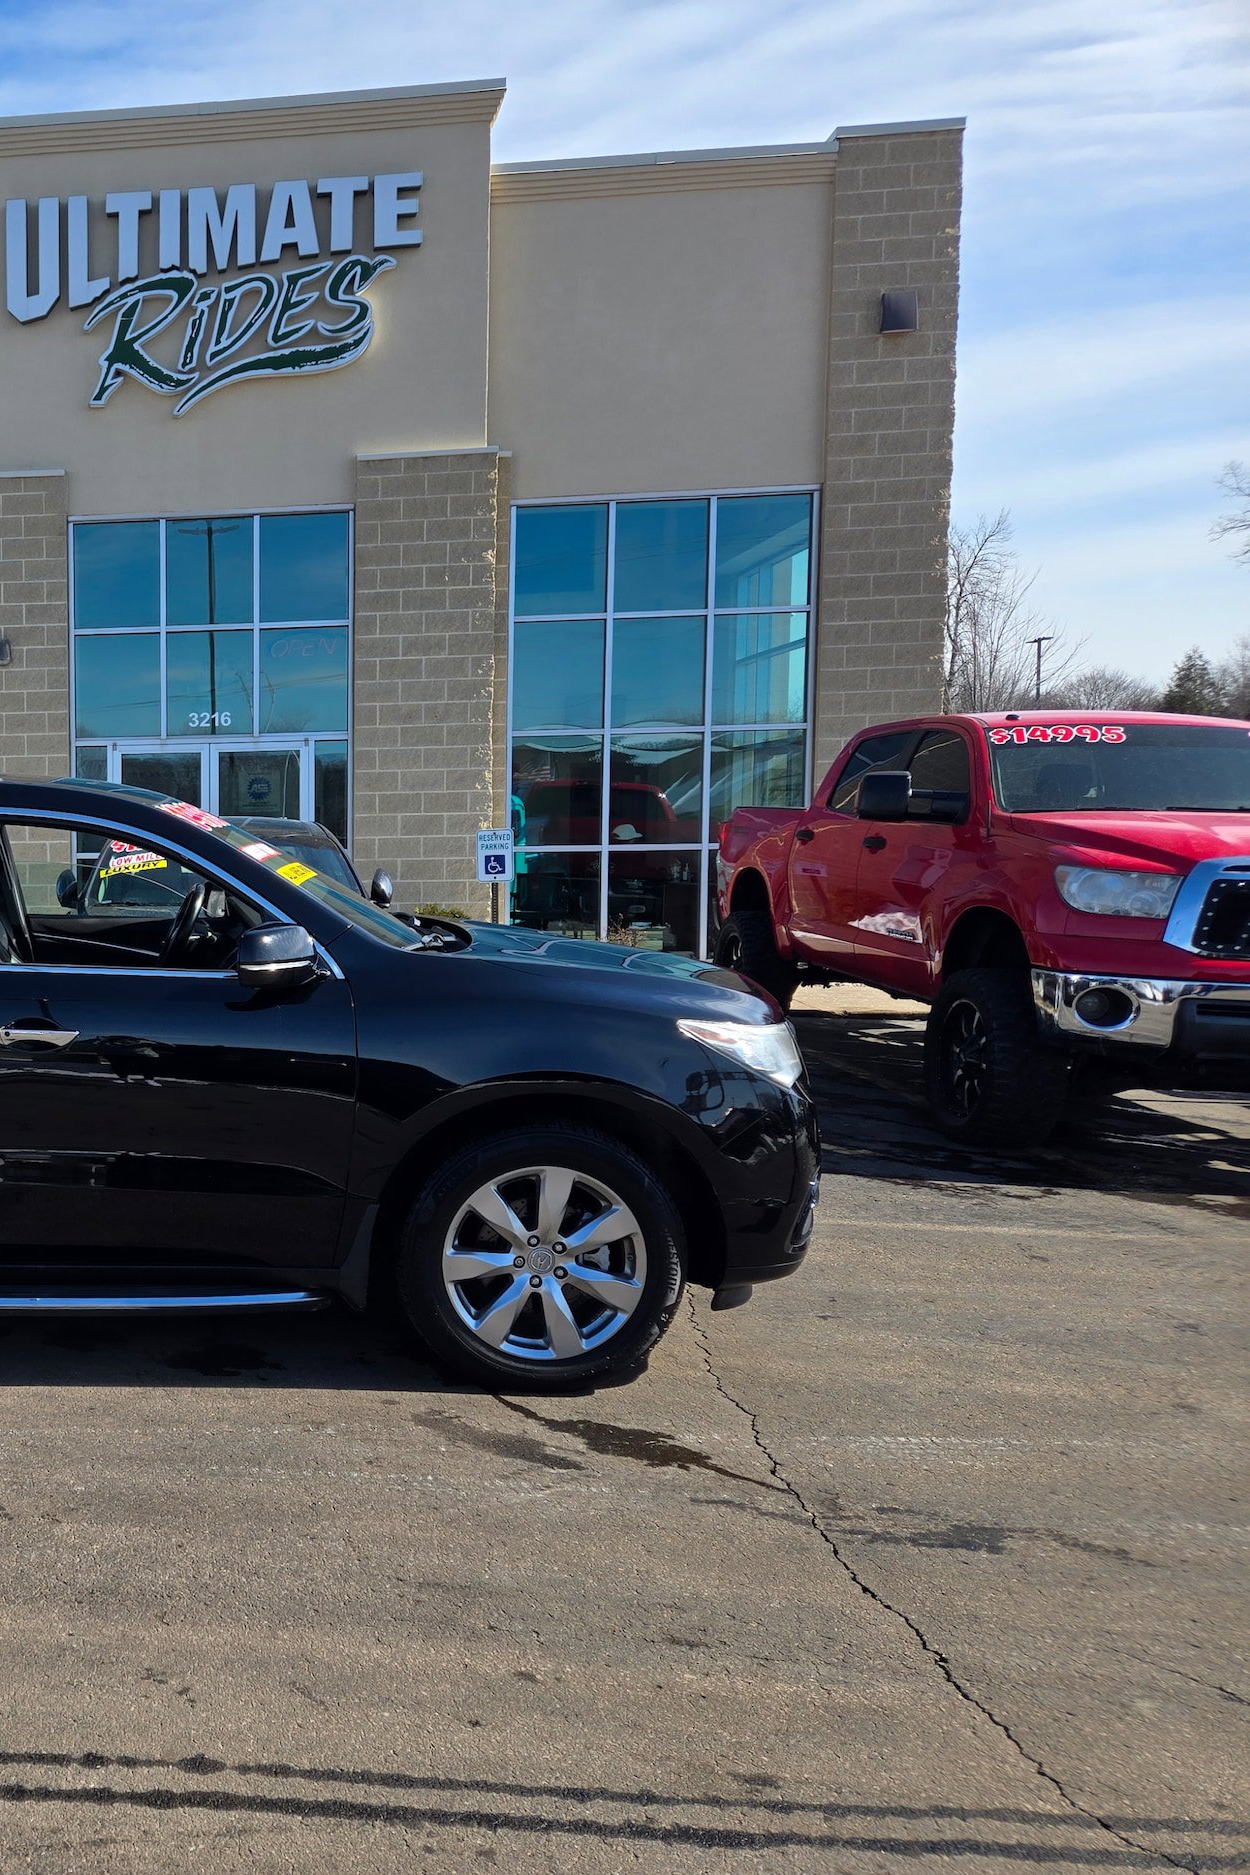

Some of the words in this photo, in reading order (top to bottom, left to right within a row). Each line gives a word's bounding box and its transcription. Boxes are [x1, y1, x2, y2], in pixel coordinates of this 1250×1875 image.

[6, 170, 424, 325] ULTIMATE
[188, 711, 232, 728] 3216
[989, 724, 1127, 745] $14995
[478, 834, 511, 842] RESERVED
[481, 842, 509, 850] PARKING
[105, 861, 160, 876] LUXURY
[111, 856, 133, 867] LOW
